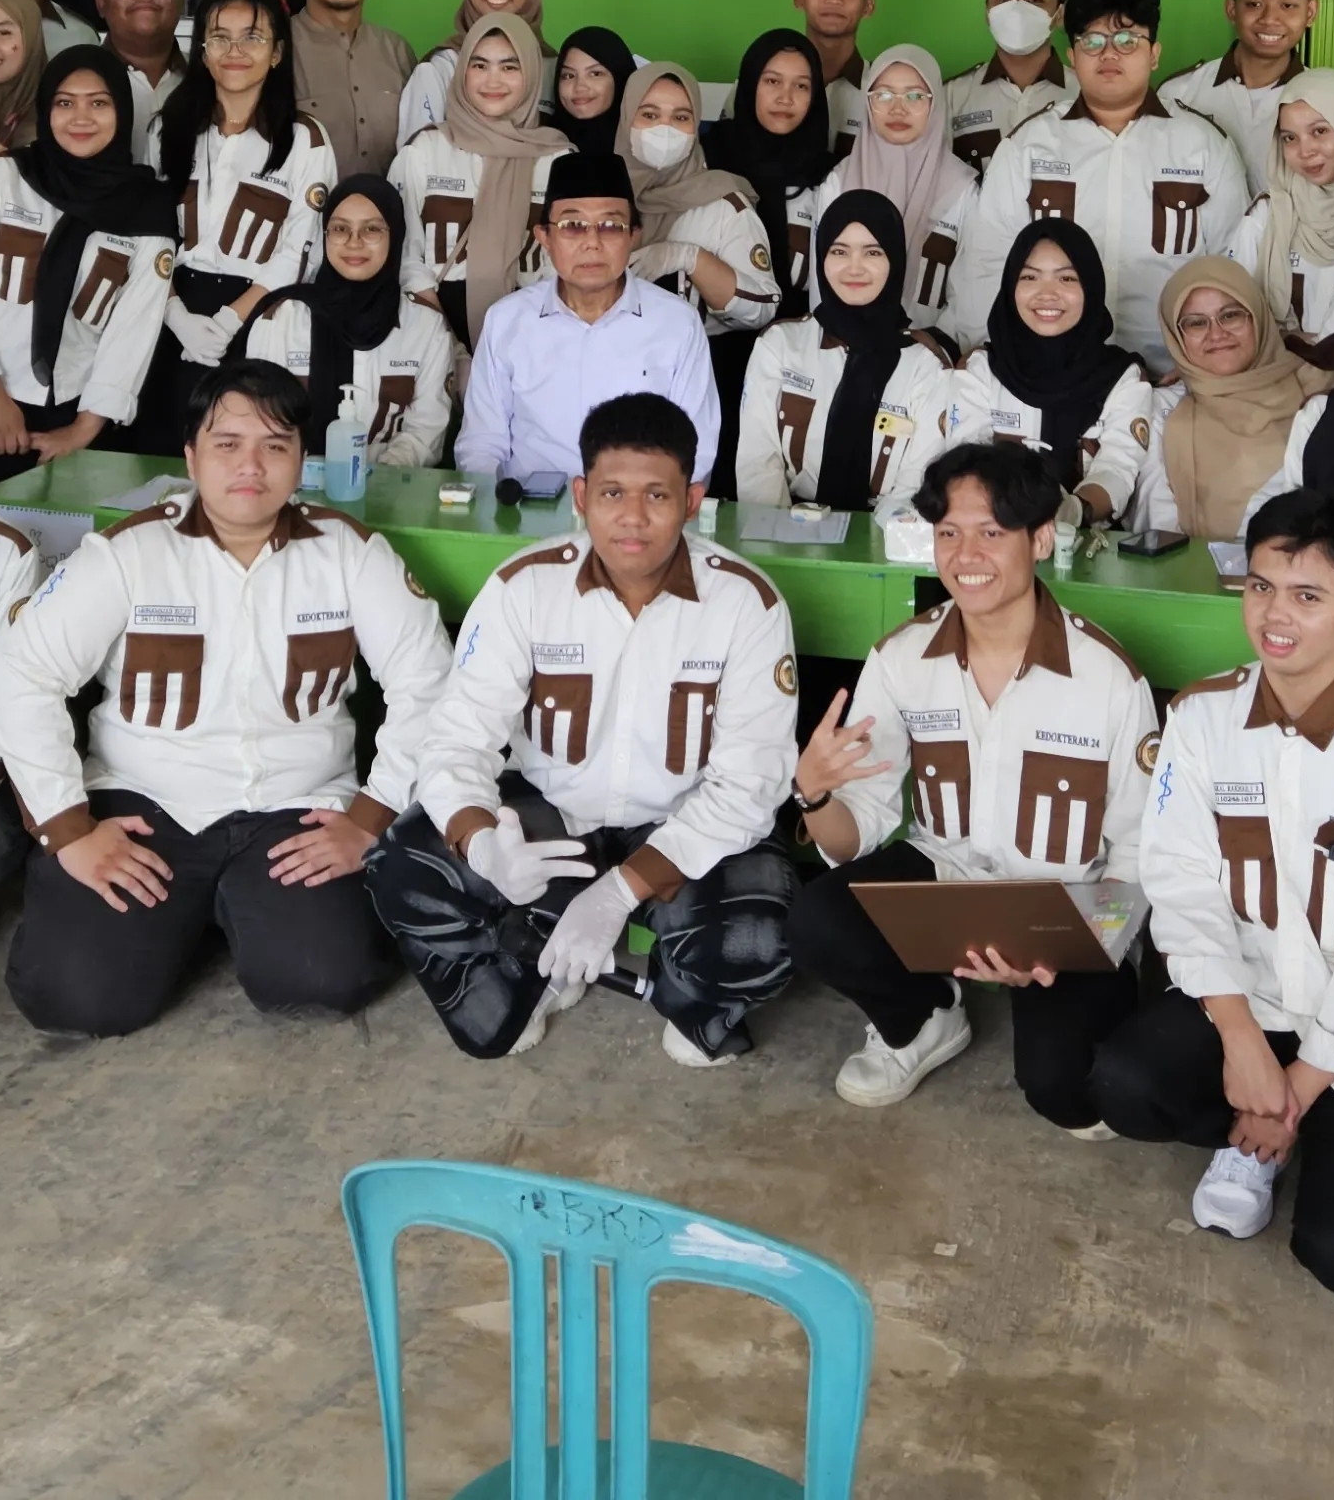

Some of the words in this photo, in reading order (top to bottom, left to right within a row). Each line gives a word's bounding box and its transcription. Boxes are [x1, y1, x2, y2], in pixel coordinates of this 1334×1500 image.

[296, 610, 344, 623] KEDOKTERAN
[1035, 729, 1089, 747] KEDOKTERAN
[1091, 739, 1100, 748] 24
